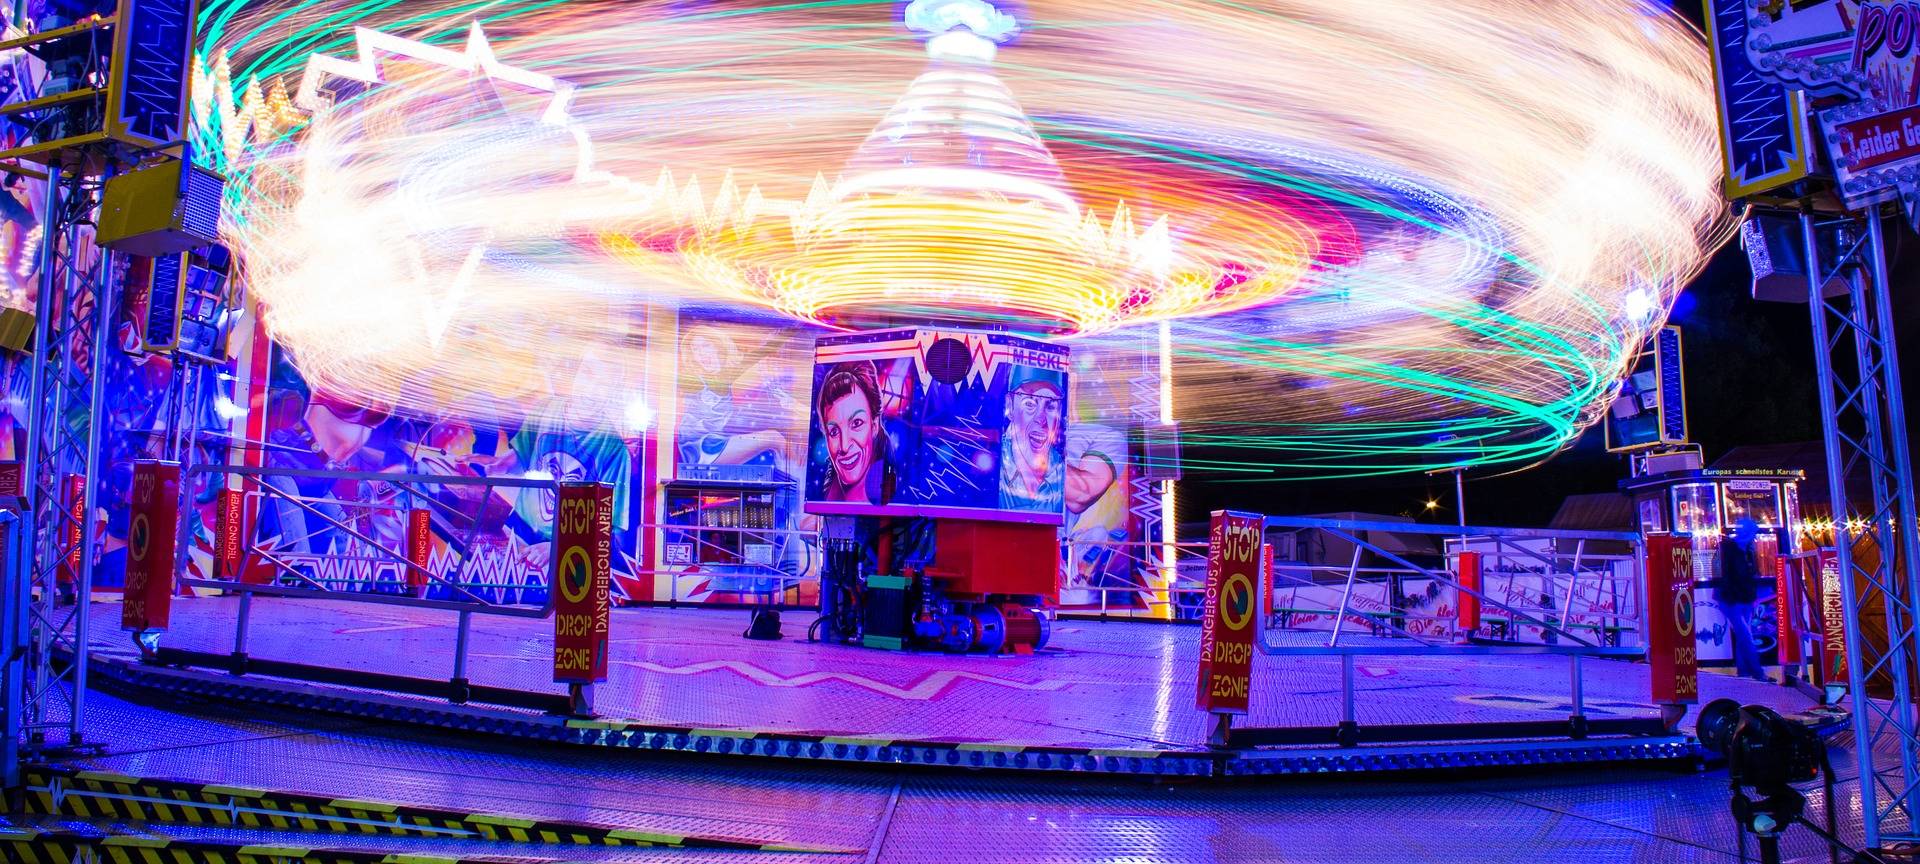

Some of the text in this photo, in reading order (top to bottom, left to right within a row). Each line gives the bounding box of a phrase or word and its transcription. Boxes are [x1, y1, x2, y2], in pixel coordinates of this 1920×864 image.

[1848, 125, 1900, 164] Leider
[1702, 468, 1732, 476] Europas
[1735, 468, 1774, 476] schnellstes
[227, 493, 241, 560] TECHNO POWER
[560, 498, 596, 534] STOP
[1223, 525, 1260, 563] STOP
[596, 495, 611, 633] DANGEROUS AREA
[1672, 547, 1693, 578] STOP
[1201, 524, 1222, 663] DANGEROUS AREA
[123, 600, 145, 619] ZONE
[556, 614, 592, 637] DROP
[555, 647, 590, 670] ZONE
[1215, 641, 1252, 665] DROP
[1675, 647, 1696, 665] DROP
[1211, 674, 1249, 698] ZONE
[1675, 675, 1697, 694] ZONE
